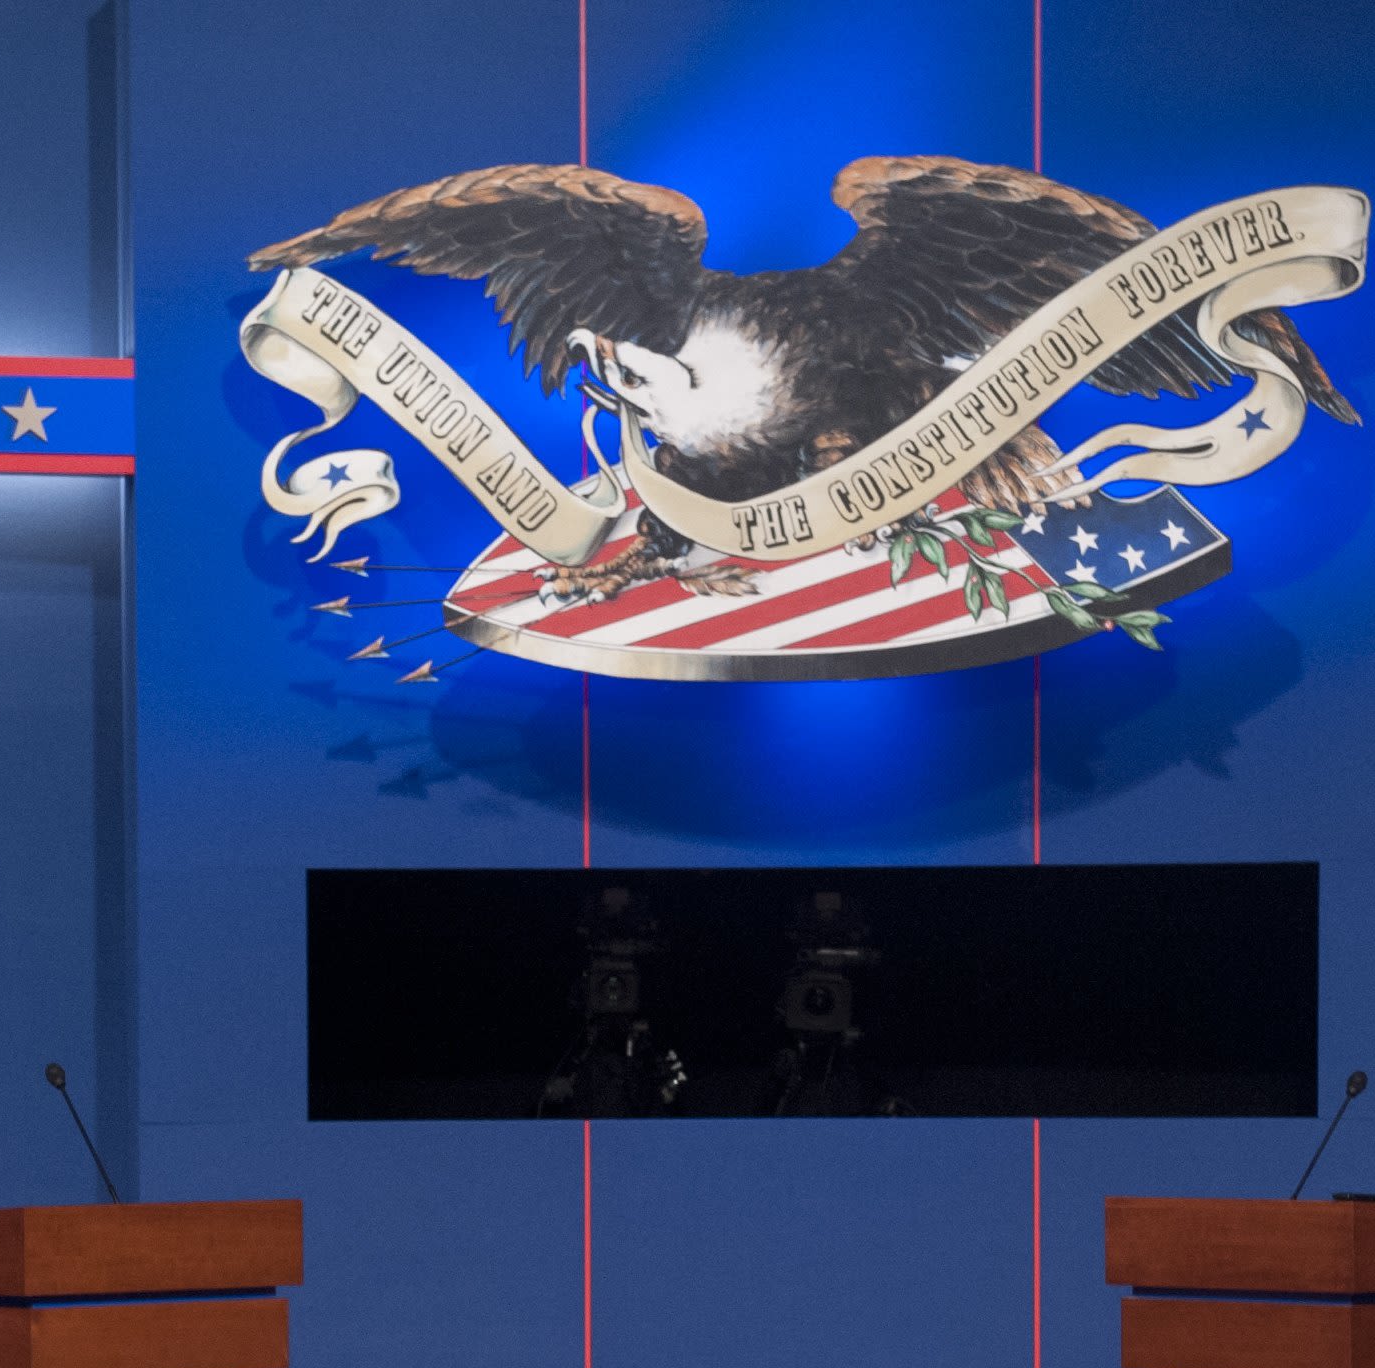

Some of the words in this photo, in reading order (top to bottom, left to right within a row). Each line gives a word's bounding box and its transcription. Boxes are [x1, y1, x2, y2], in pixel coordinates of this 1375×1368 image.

[301, 278, 382, 360] THE
[375, 341, 492, 463] UNION
[476, 451, 558, 532] AND
[732, 495, 814, 551] THE
[828, 306, 1104, 523] CONSTITUTION
[1106, 200, 1306, 319] FOREVER.
